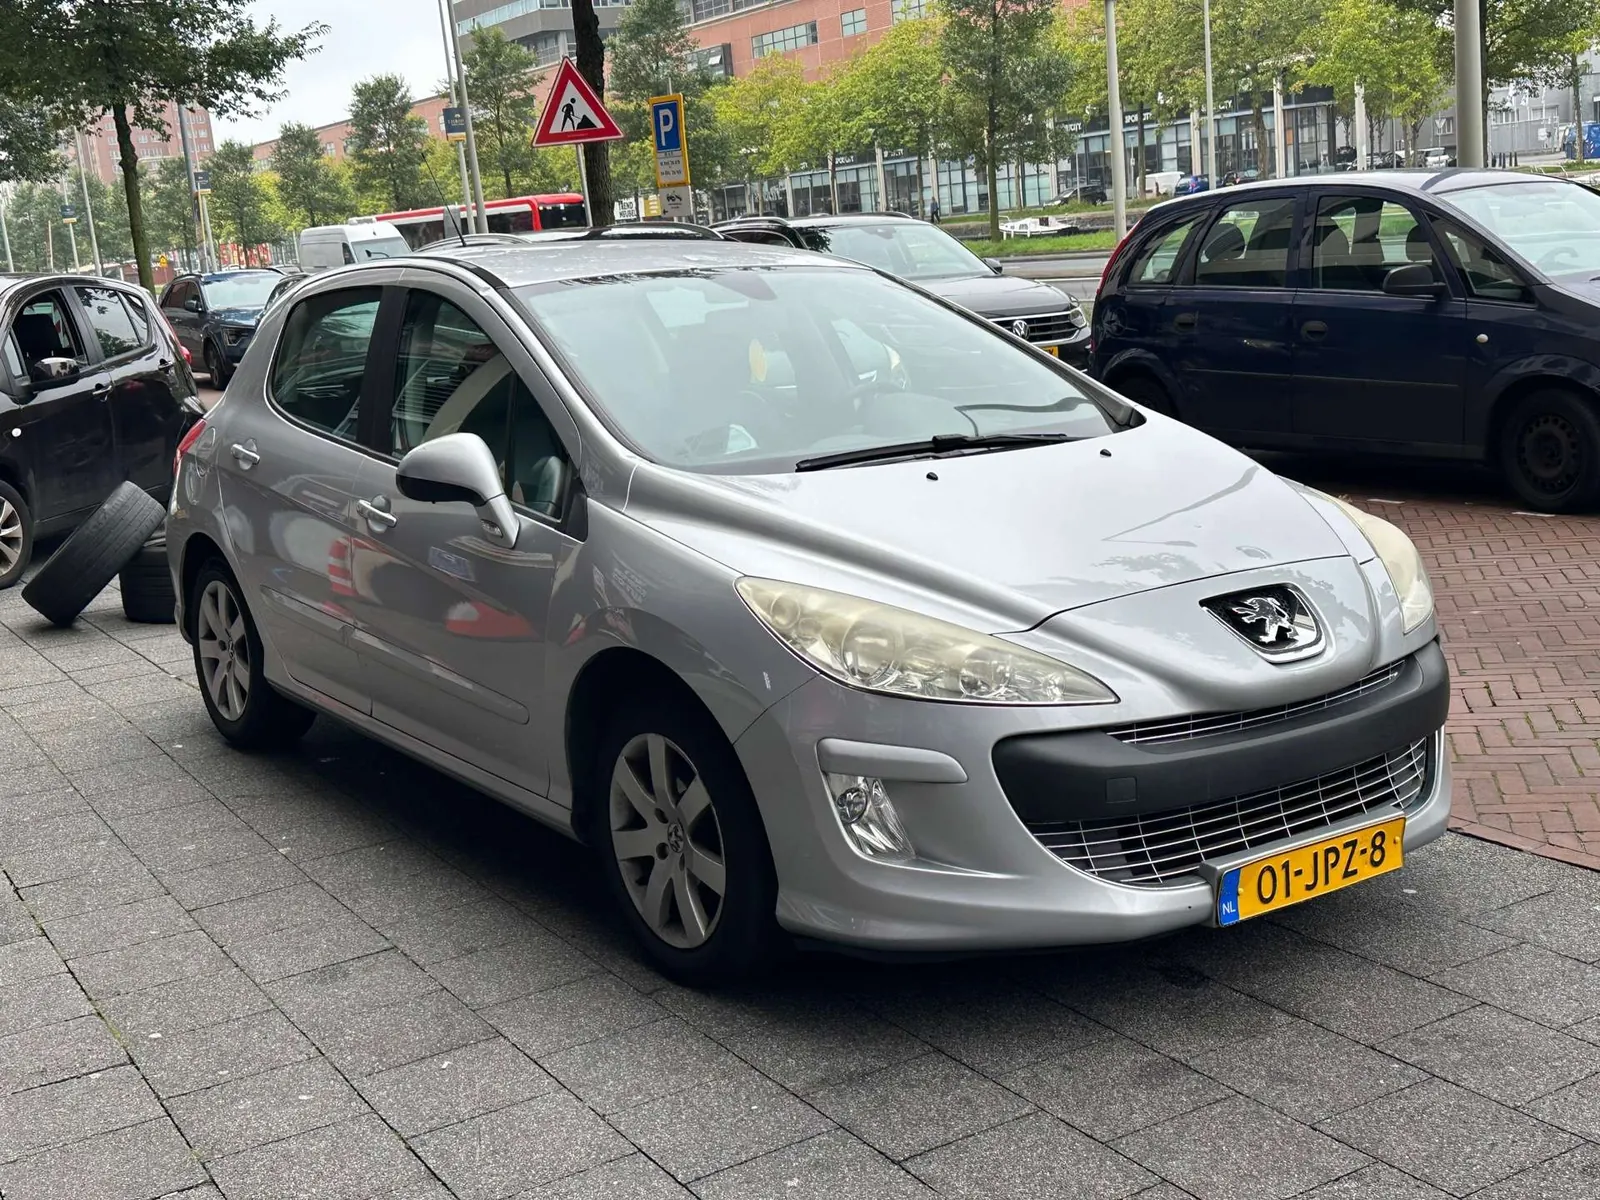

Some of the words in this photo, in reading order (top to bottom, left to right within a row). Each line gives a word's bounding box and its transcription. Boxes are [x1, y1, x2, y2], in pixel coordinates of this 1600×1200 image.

[658, 108, 674, 147] P
[1257, 830, 1386, 905] 01-JPZ-8
[1222, 901, 1236, 916] NL
